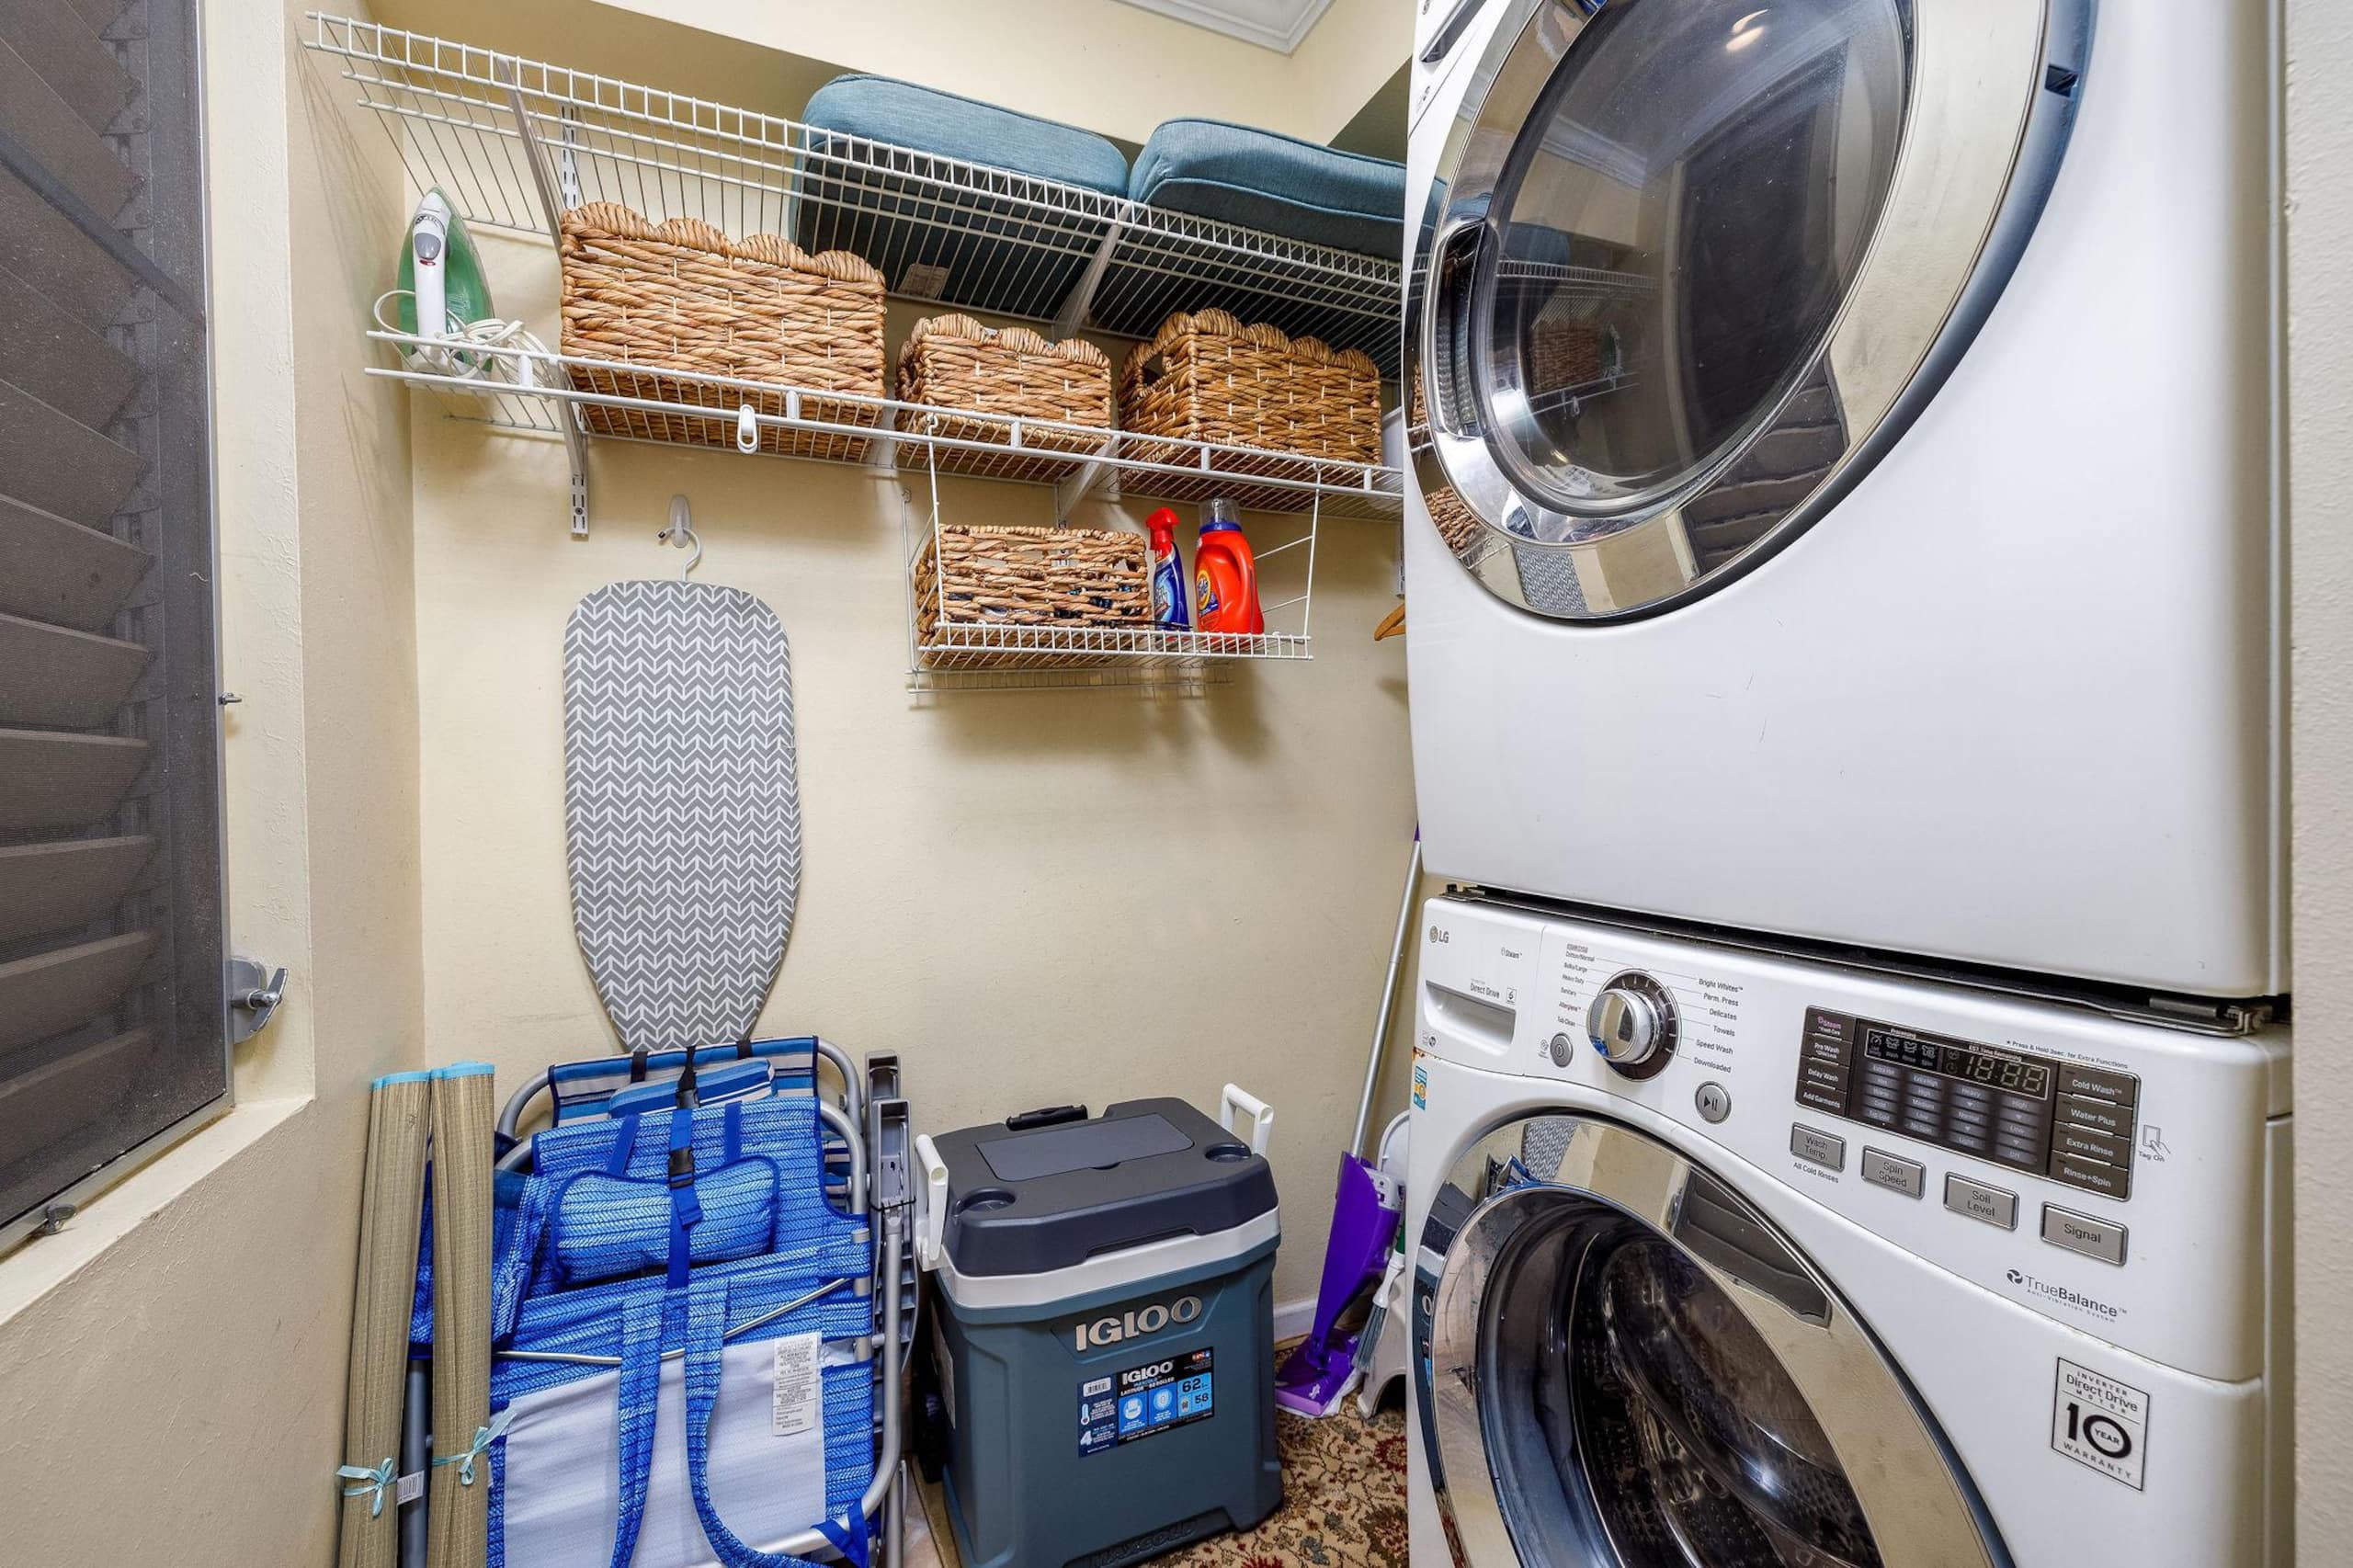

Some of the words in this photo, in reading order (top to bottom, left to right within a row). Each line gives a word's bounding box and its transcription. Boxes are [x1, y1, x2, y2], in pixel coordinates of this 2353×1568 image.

[1438, 929, 1449, 943] LG
[1471, 983, 1485, 994] Direct
[1486, 986, 1500, 998] Drive
[1699, 978, 1716, 988] Bright
[1722, 996, 1739, 1006] Press
[1709, 1008, 1737, 1020] Delicates
[1713, 1025, 1735, 1037] Towels
[1696, 1039, 1715, 1050] Speed
[1715, 1043, 1733, 1055] Wash
[1824, 1044, 1840, 1053] Wash
[2013, 1040, 2029, 1050] Press
[2035, 1045, 2050, 1053] Hold
[2077, 1053, 2096, 1062] Extra
[2096, 1057, 2129, 1069] Functions
[1694, 1057, 1732, 1073] Downloaded
[1808, 1068, 1823, 1079] Delay
[1823, 1072, 1839, 1082] Wash
[1961, 1087, 1981, 1098] Heavy
[2072, 1079, 2090, 1091] Cold
[1803, 1091, 1814, 1101] Add
[2070, 1108, 2097, 1122] Water
[2097, 1115, 2117, 1127] Plus
[1806, 1135, 1828, 1150] Wash
[2066, 1137, 2089, 1150] Extra
[2090, 1143, 2114, 1157] Rinse
[1804, 1144, 1827, 1160] Temp.
[2139, 1151, 2152, 1162] Tag
[1802, 1165, 1817, 1176] Cold
[1817, 1169, 1839, 1184] Rinses
[1883, 1162, 1904, 1176] Spin
[2063, 1166, 2111, 1187] Rinse+Spin
[1879, 1170, 1907, 1187] Speed
[1972, 1190, 1991, 1204] Soil
[1967, 1200, 1995, 1217] Level
[2063, 1223, 2102, 1244] Signal
[1075, 1295, 1203, 1352] IGLOO
[1122, 1361, 1174, 1385] IGLOO
[1182, 1378, 1201, 1393] 62
[2077, 1371, 2128, 1396] INVERTER
[1195, 1392, 1210, 1404] 58
[2066, 1374, 2102, 1397] Direct
[2106, 1391, 2138, 1412] Drive
[2076, 1389, 2126, 1414] MOTOR
[1080, 1430, 1093, 1447] 4
[2066, 1402, 2132, 1460] 10
[2095, 1427, 2120, 1445] YEAR
[2063, 1441, 2132, 1480] WARRANTY
